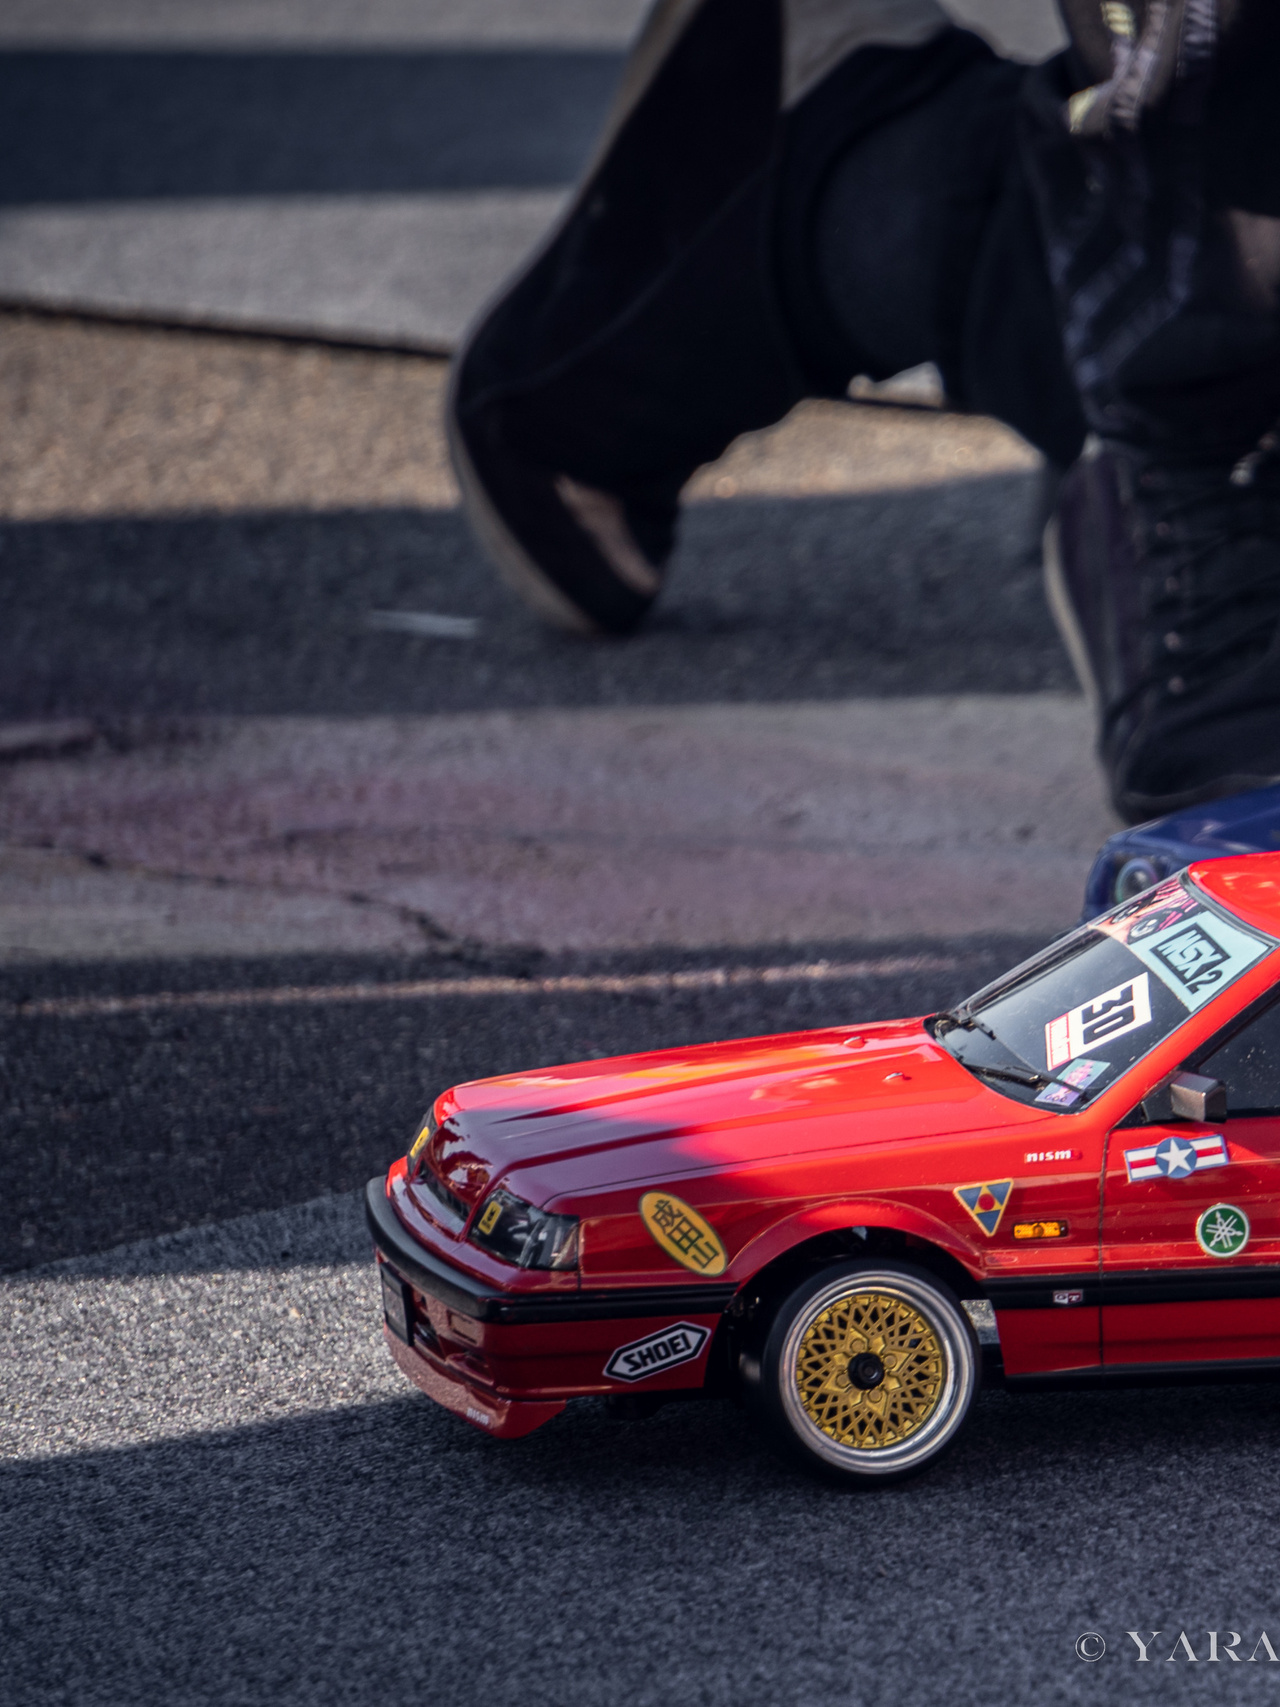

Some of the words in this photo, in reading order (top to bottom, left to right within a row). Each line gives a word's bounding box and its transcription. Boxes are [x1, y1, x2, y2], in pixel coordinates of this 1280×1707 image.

[1082, 984, 1136, 1046] 30
[651, 1199, 720, 1269] 成田山
[622, 1331, 692, 1373] SHOEI
